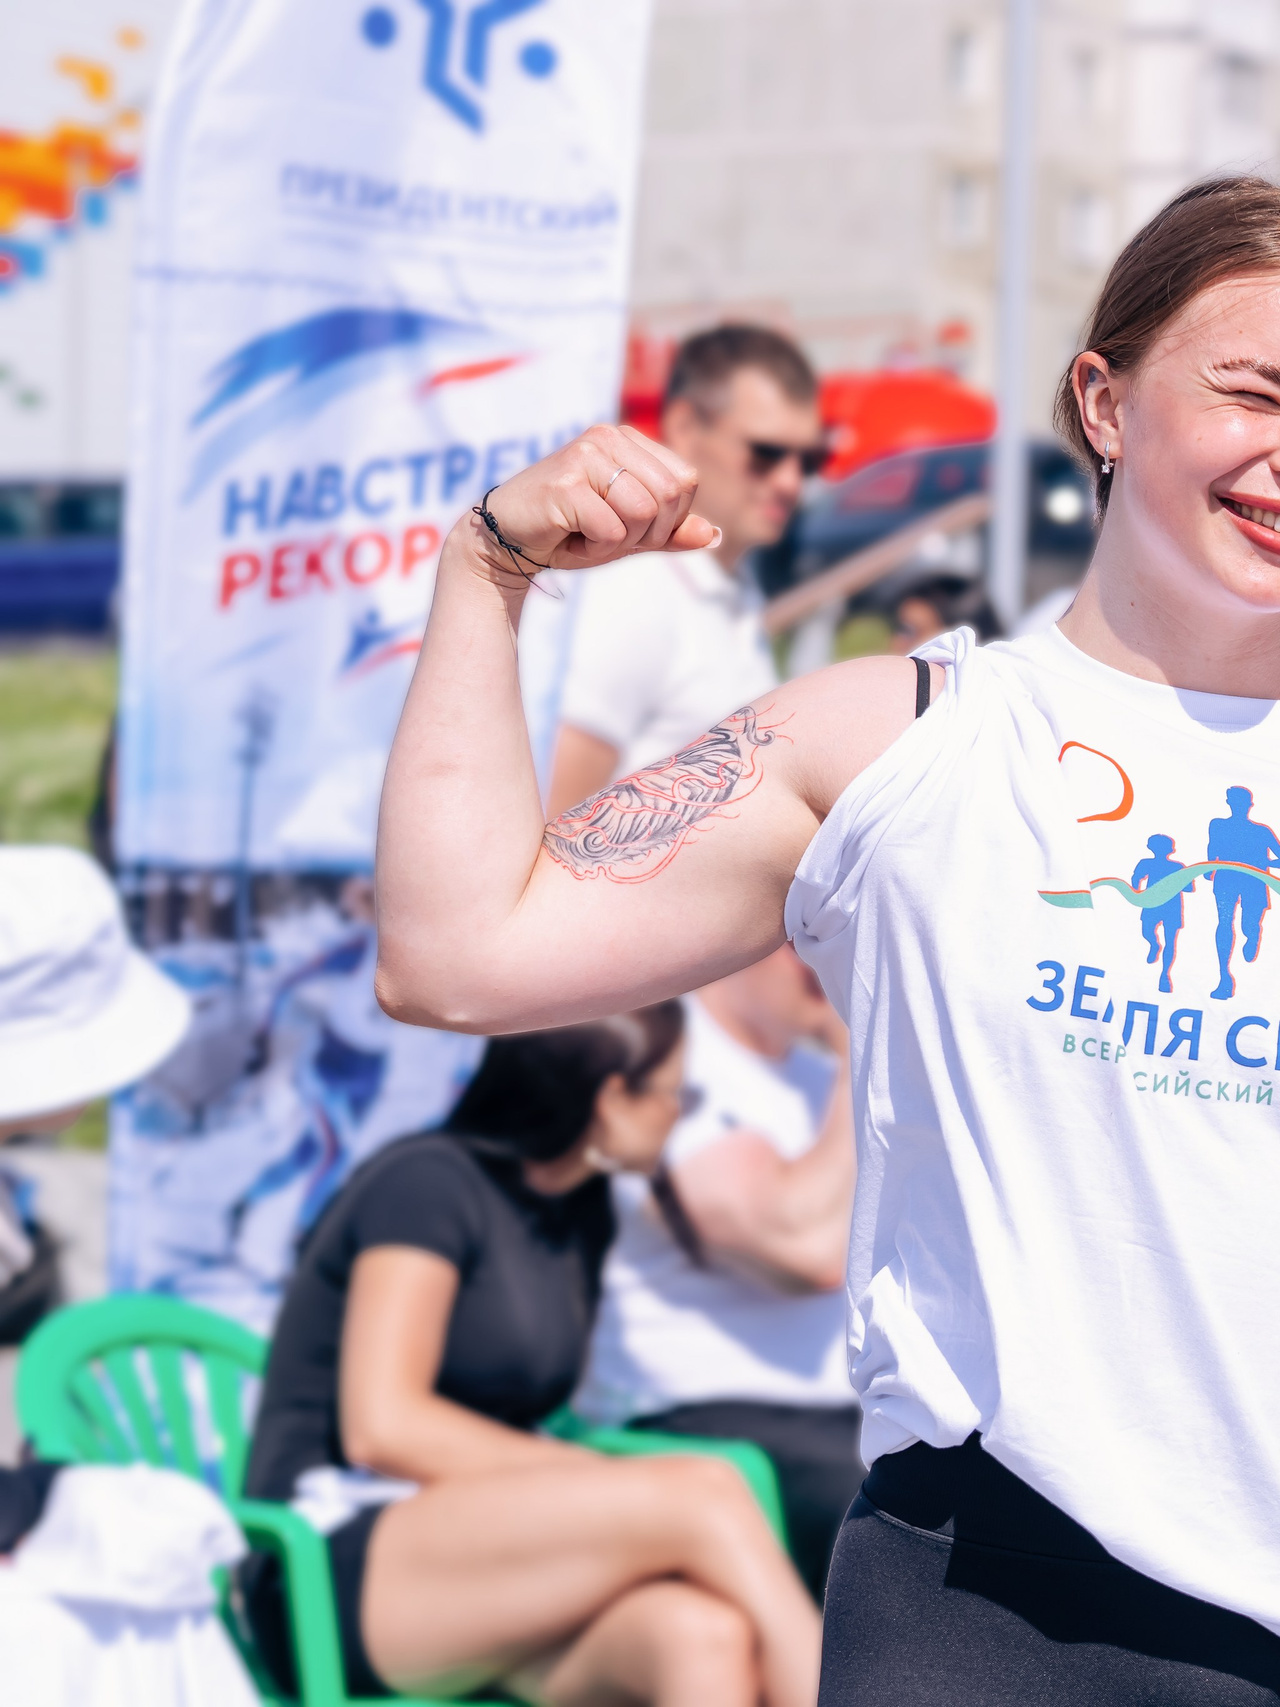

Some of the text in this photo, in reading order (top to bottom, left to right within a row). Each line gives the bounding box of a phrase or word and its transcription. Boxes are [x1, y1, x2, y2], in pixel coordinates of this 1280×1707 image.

[280, 163, 620, 232] ПРЕЗИДЕНТСКИЙ
[222, 422, 584, 537] НАВСТРЕ
[218, 522, 441, 611] РЕКОР
[1062, 1033, 1274, 1106] ВСЕРСИЙСКИЙ
